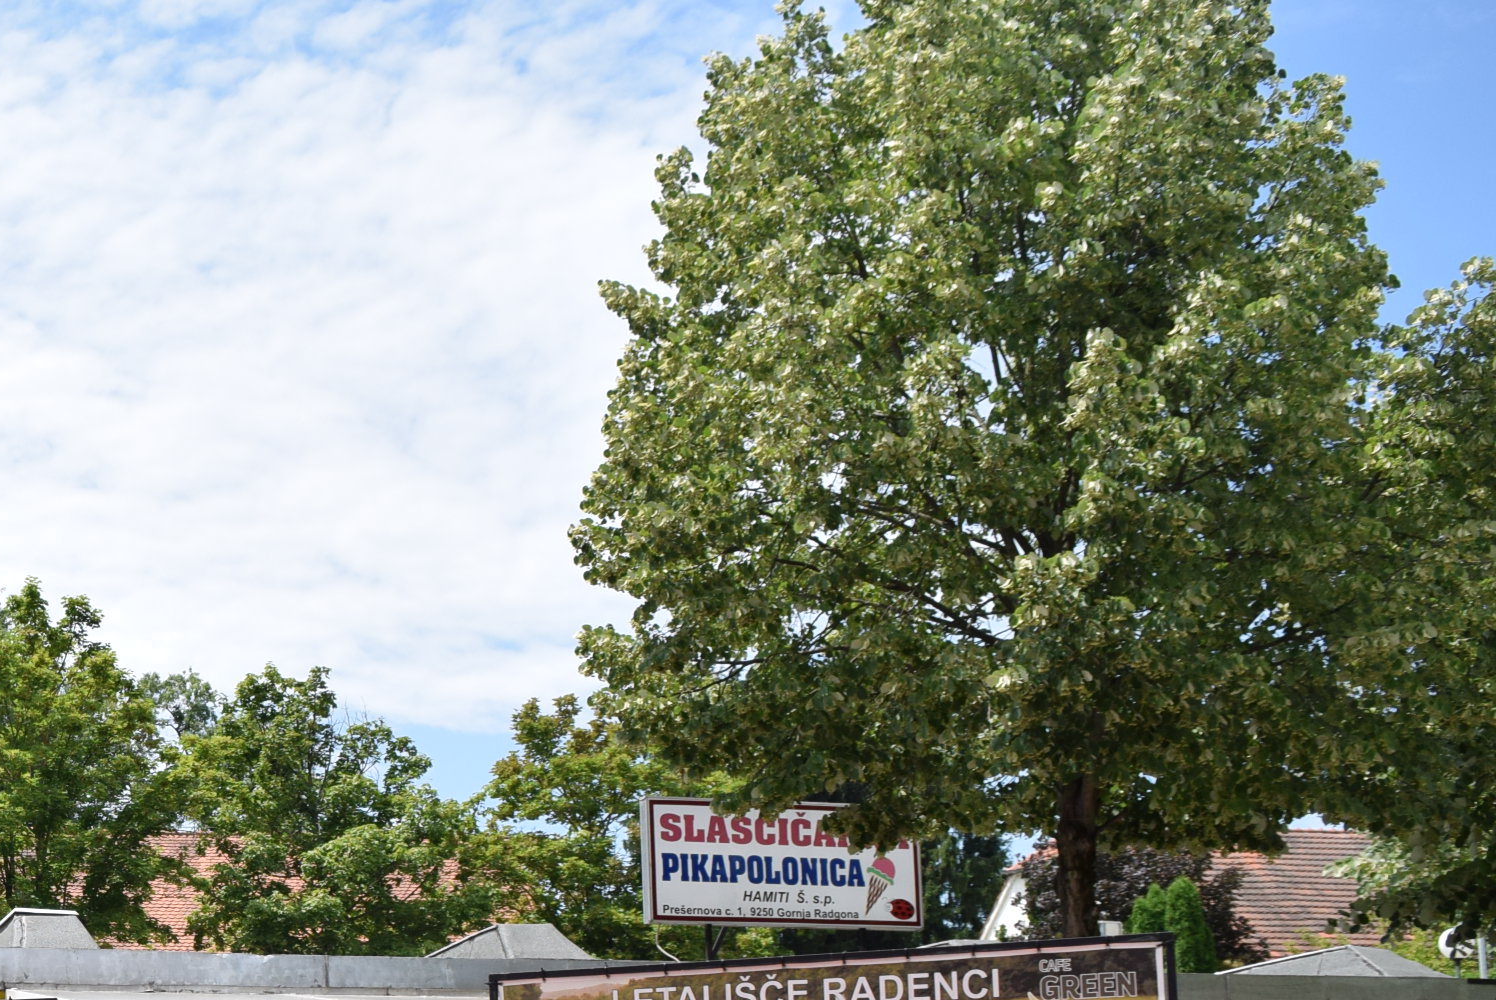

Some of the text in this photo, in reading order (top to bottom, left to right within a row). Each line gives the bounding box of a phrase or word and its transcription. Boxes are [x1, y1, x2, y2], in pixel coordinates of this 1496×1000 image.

[661, 852, 866, 887] PIKAPOLONICA
[743, 889, 835, 906] HAMITI Š. s.p.
[662, 904, 859, 920] Prešernova c. 1, 9250 Gornja Radgona
[1038, 958, 1072, 973] CAFE
[1039, 971, 1139, 1000] GREEN
